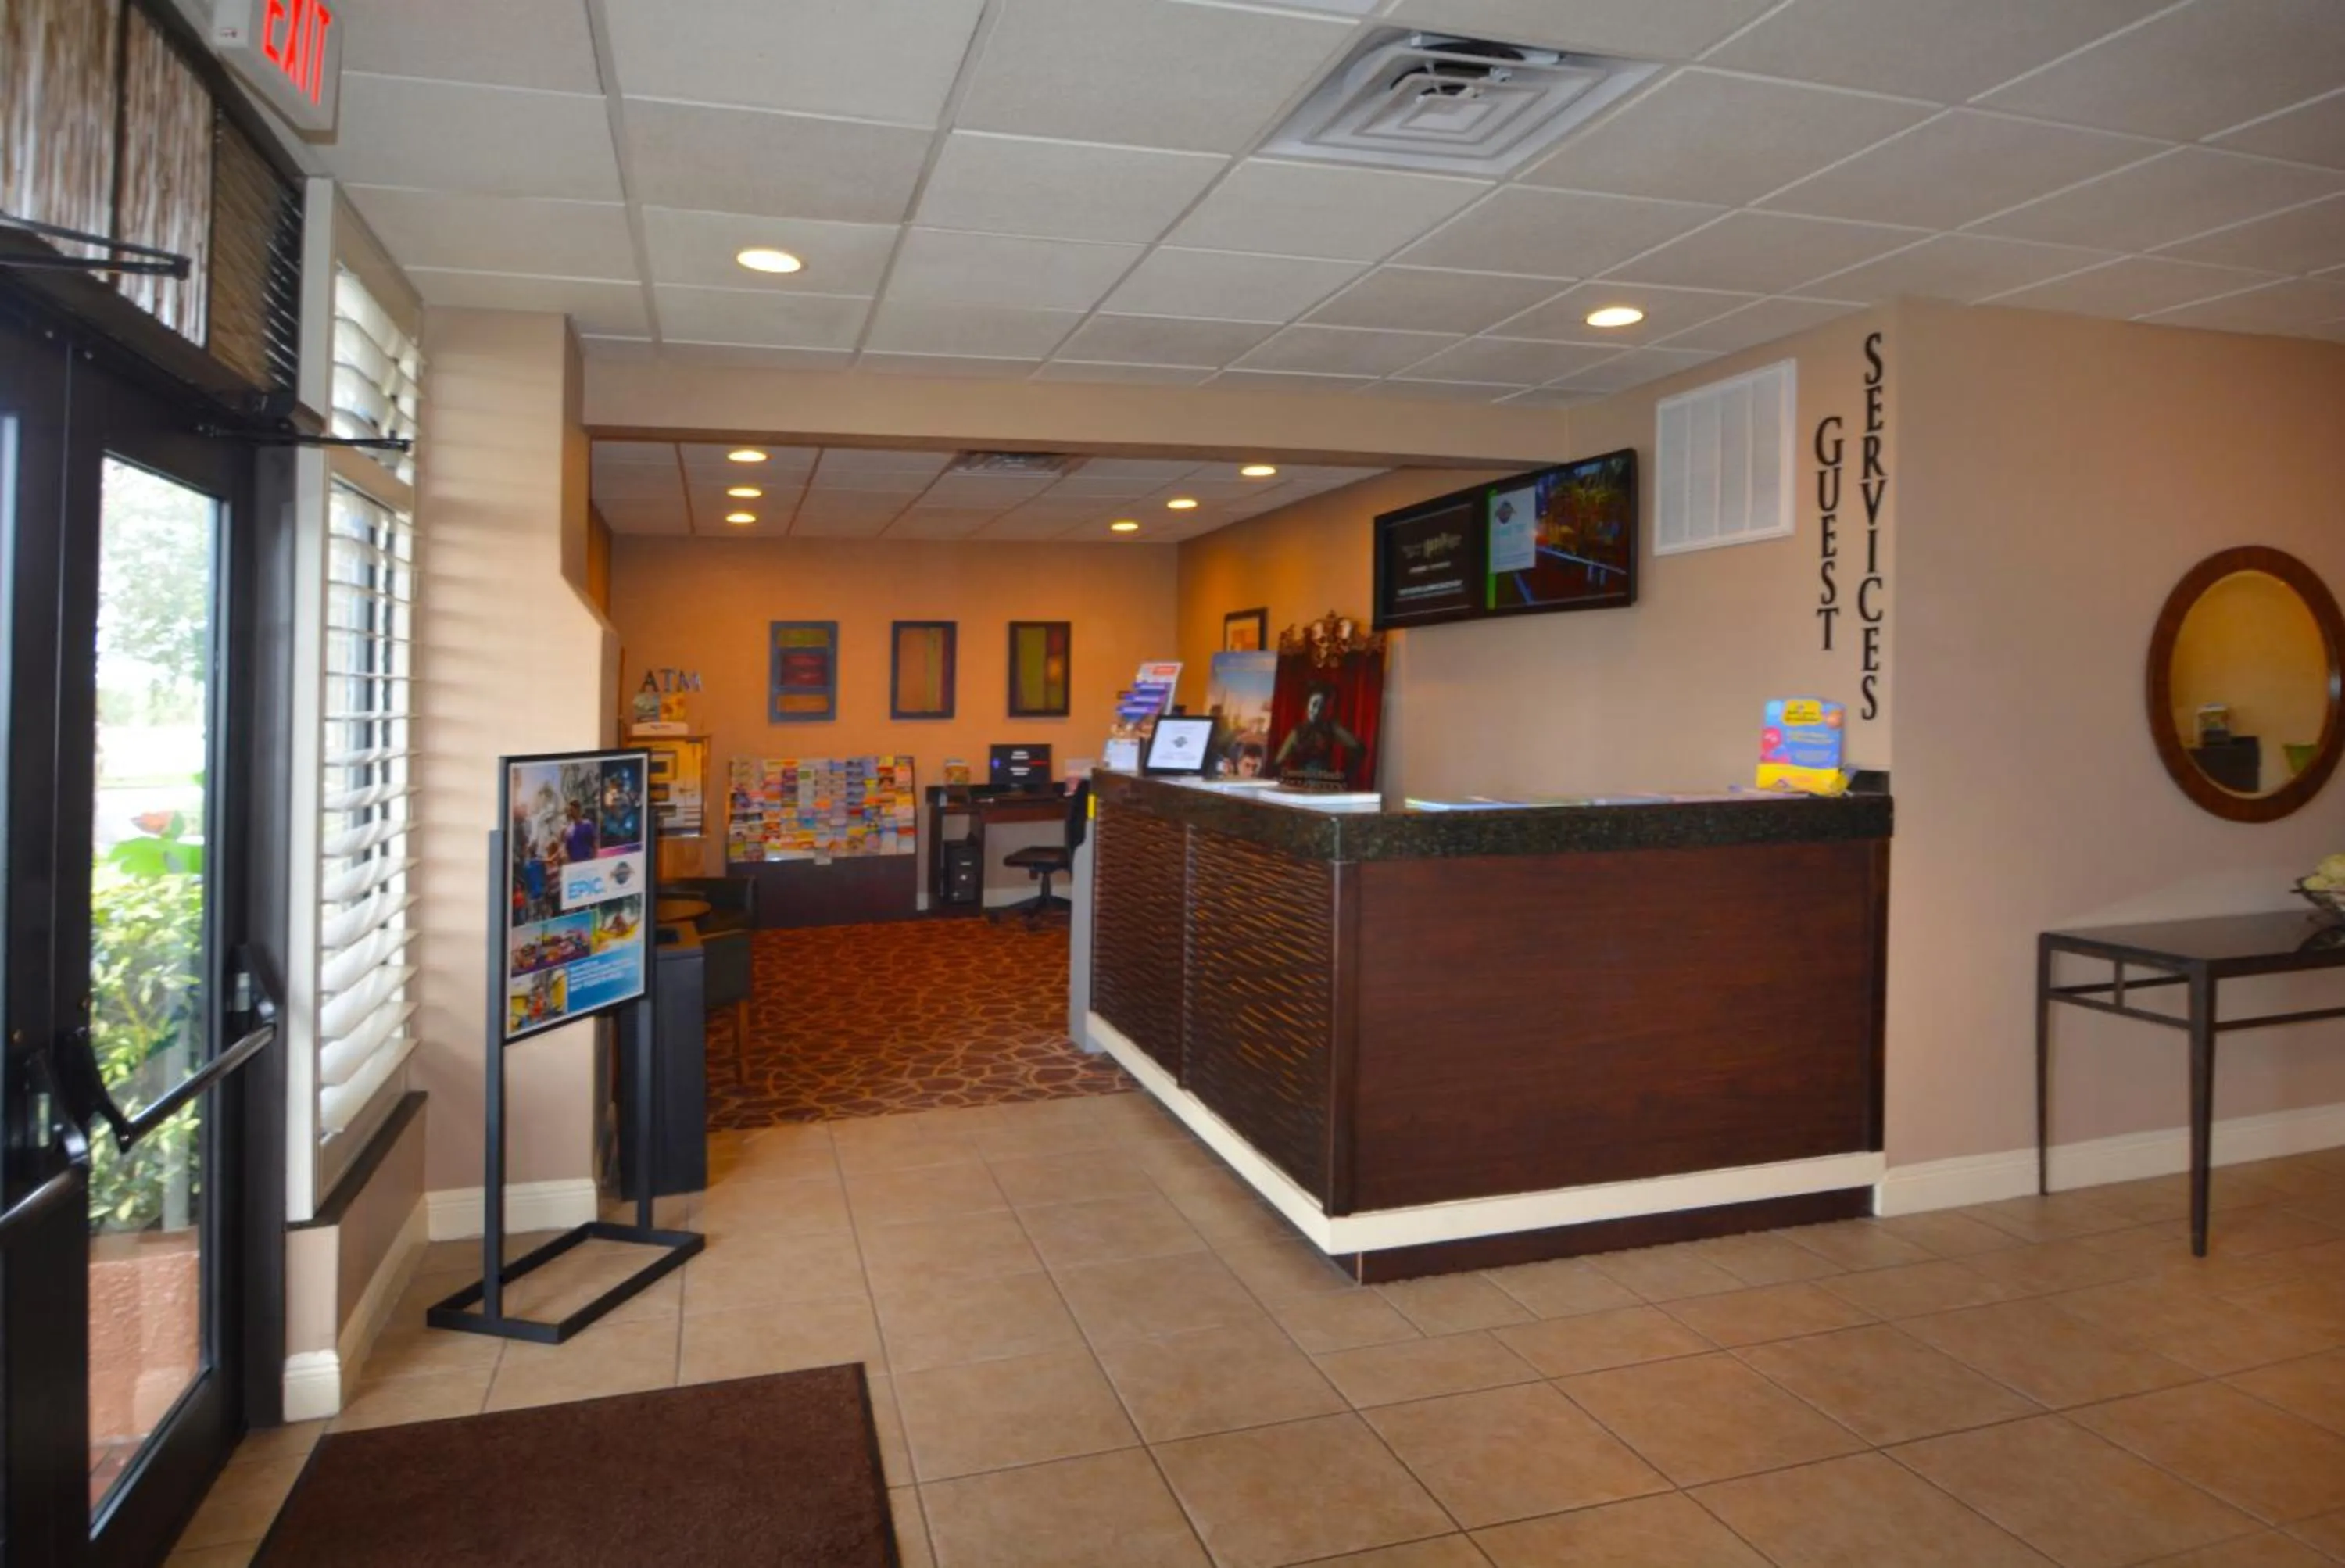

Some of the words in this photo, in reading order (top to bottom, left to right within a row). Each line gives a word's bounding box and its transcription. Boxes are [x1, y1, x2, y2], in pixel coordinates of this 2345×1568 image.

[263, 0, 331, 105] EXIT
[1814, 416, 1844, 650] GUEST
[1858, 332, 1886, 720] SERVICES
[638, 668, 702, 693] ATM
